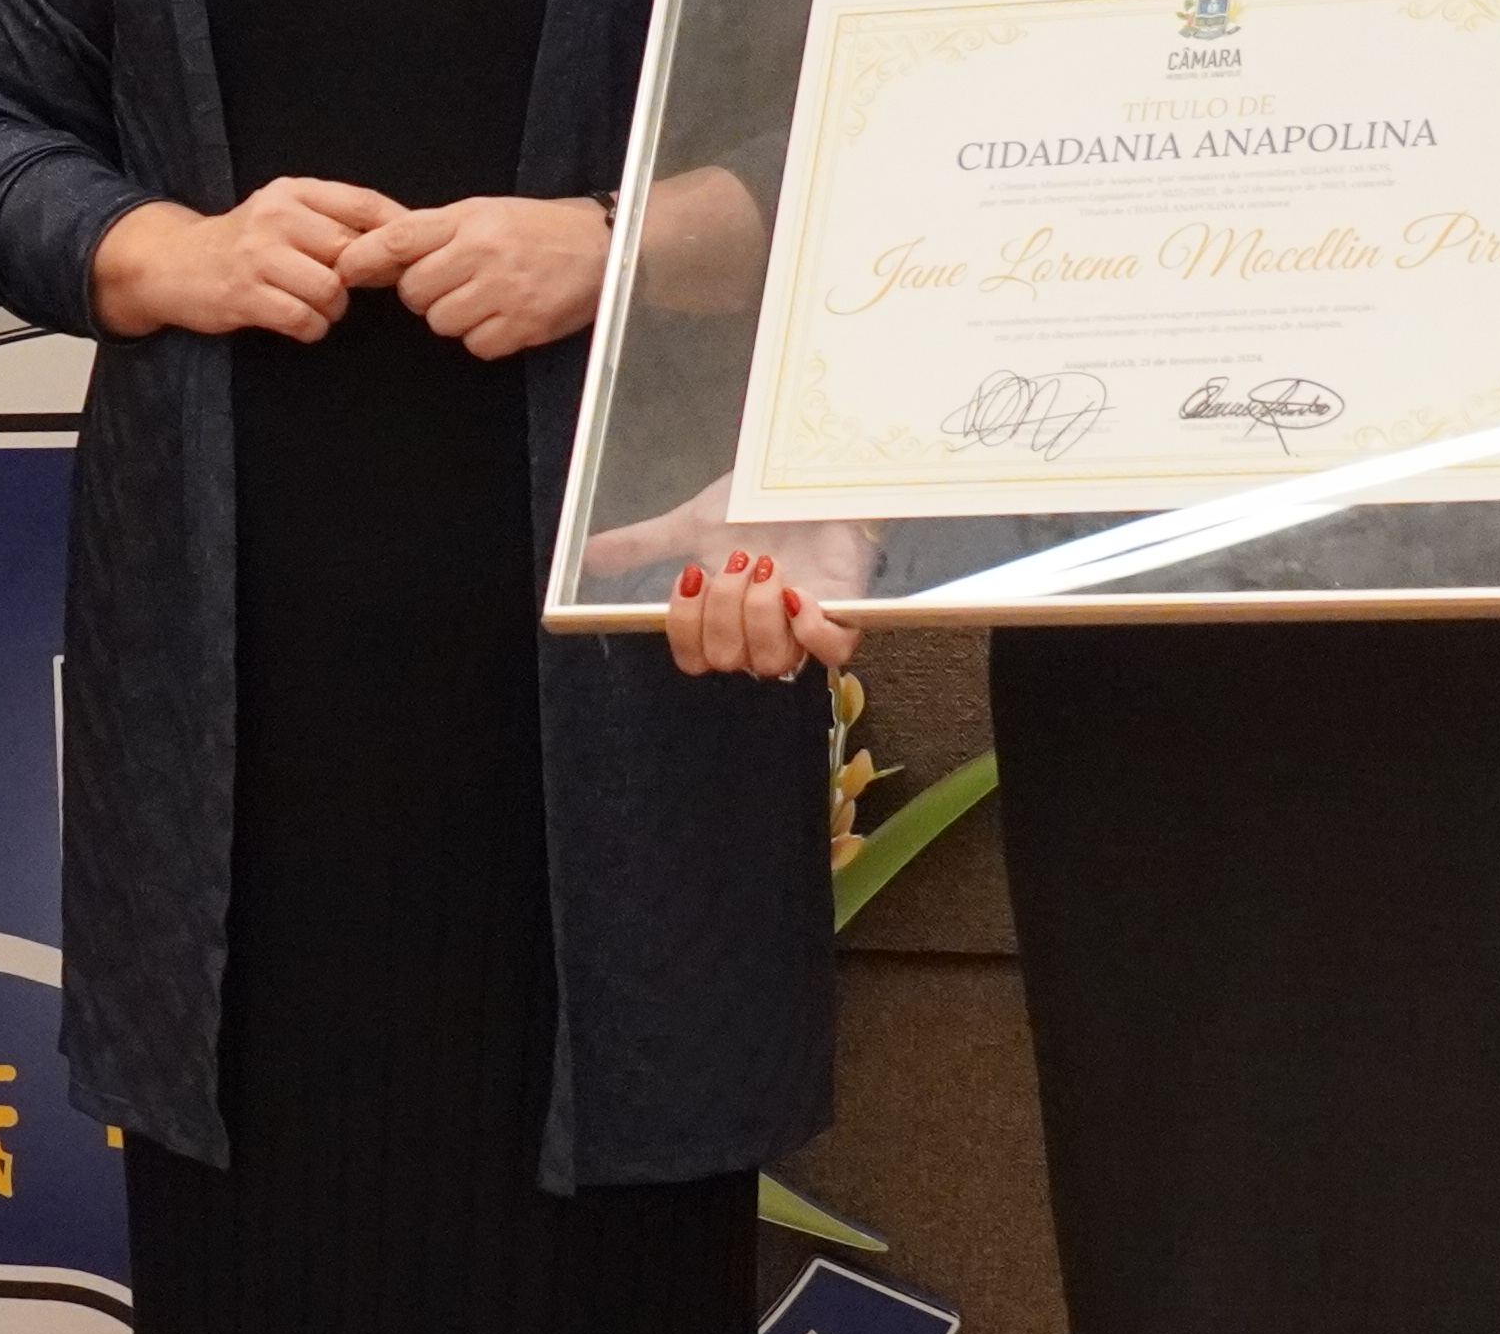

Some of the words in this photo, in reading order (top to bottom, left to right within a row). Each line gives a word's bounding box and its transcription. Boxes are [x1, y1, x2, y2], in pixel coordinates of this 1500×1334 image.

[1167, 47, 1242, 70] CÂMARA
[1122, 97, 1229, 123] TÍTULO
[1237, 94, 1276, 116] DE
[956, 132, 1182, 170] CIDADANIA
[1193, 117, 1438, 158] ANAPOLINA
[979, 226, 1139, 300] Lorena
